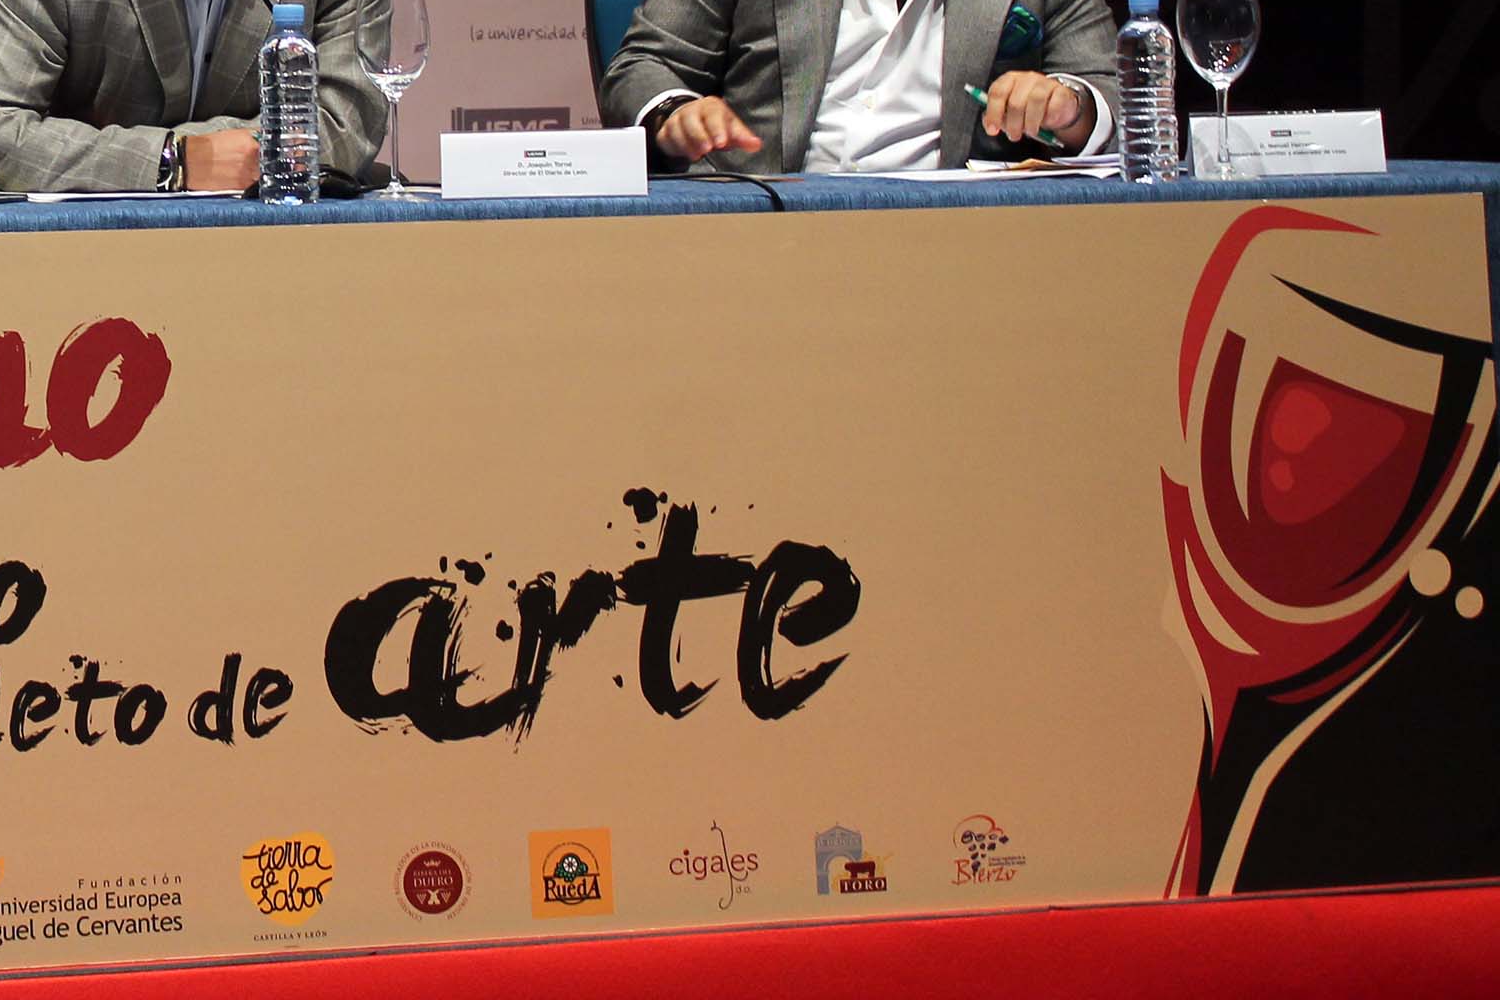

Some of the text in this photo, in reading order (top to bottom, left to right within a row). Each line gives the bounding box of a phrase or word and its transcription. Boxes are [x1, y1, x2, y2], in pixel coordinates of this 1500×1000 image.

[470, 26, 484, 42] la
[488, 25, 576, 40] universidad
[188, 653, 293, 748] de
[324, 487, 861, 752] arte
[243, 841, 332, 872] tierra
[79, 873, 181, 888] Fundación
[251, 868, 278, 889] de
[844, 878, 886, 892] TORO
[106, 892, 181, 911] Europea
[258, 869, 332, 914] sabor
[43, 917, 69, 938] de
[77, 914, 182, 936] Cervantes
[254, 933, 293, 941] CASTILLA
